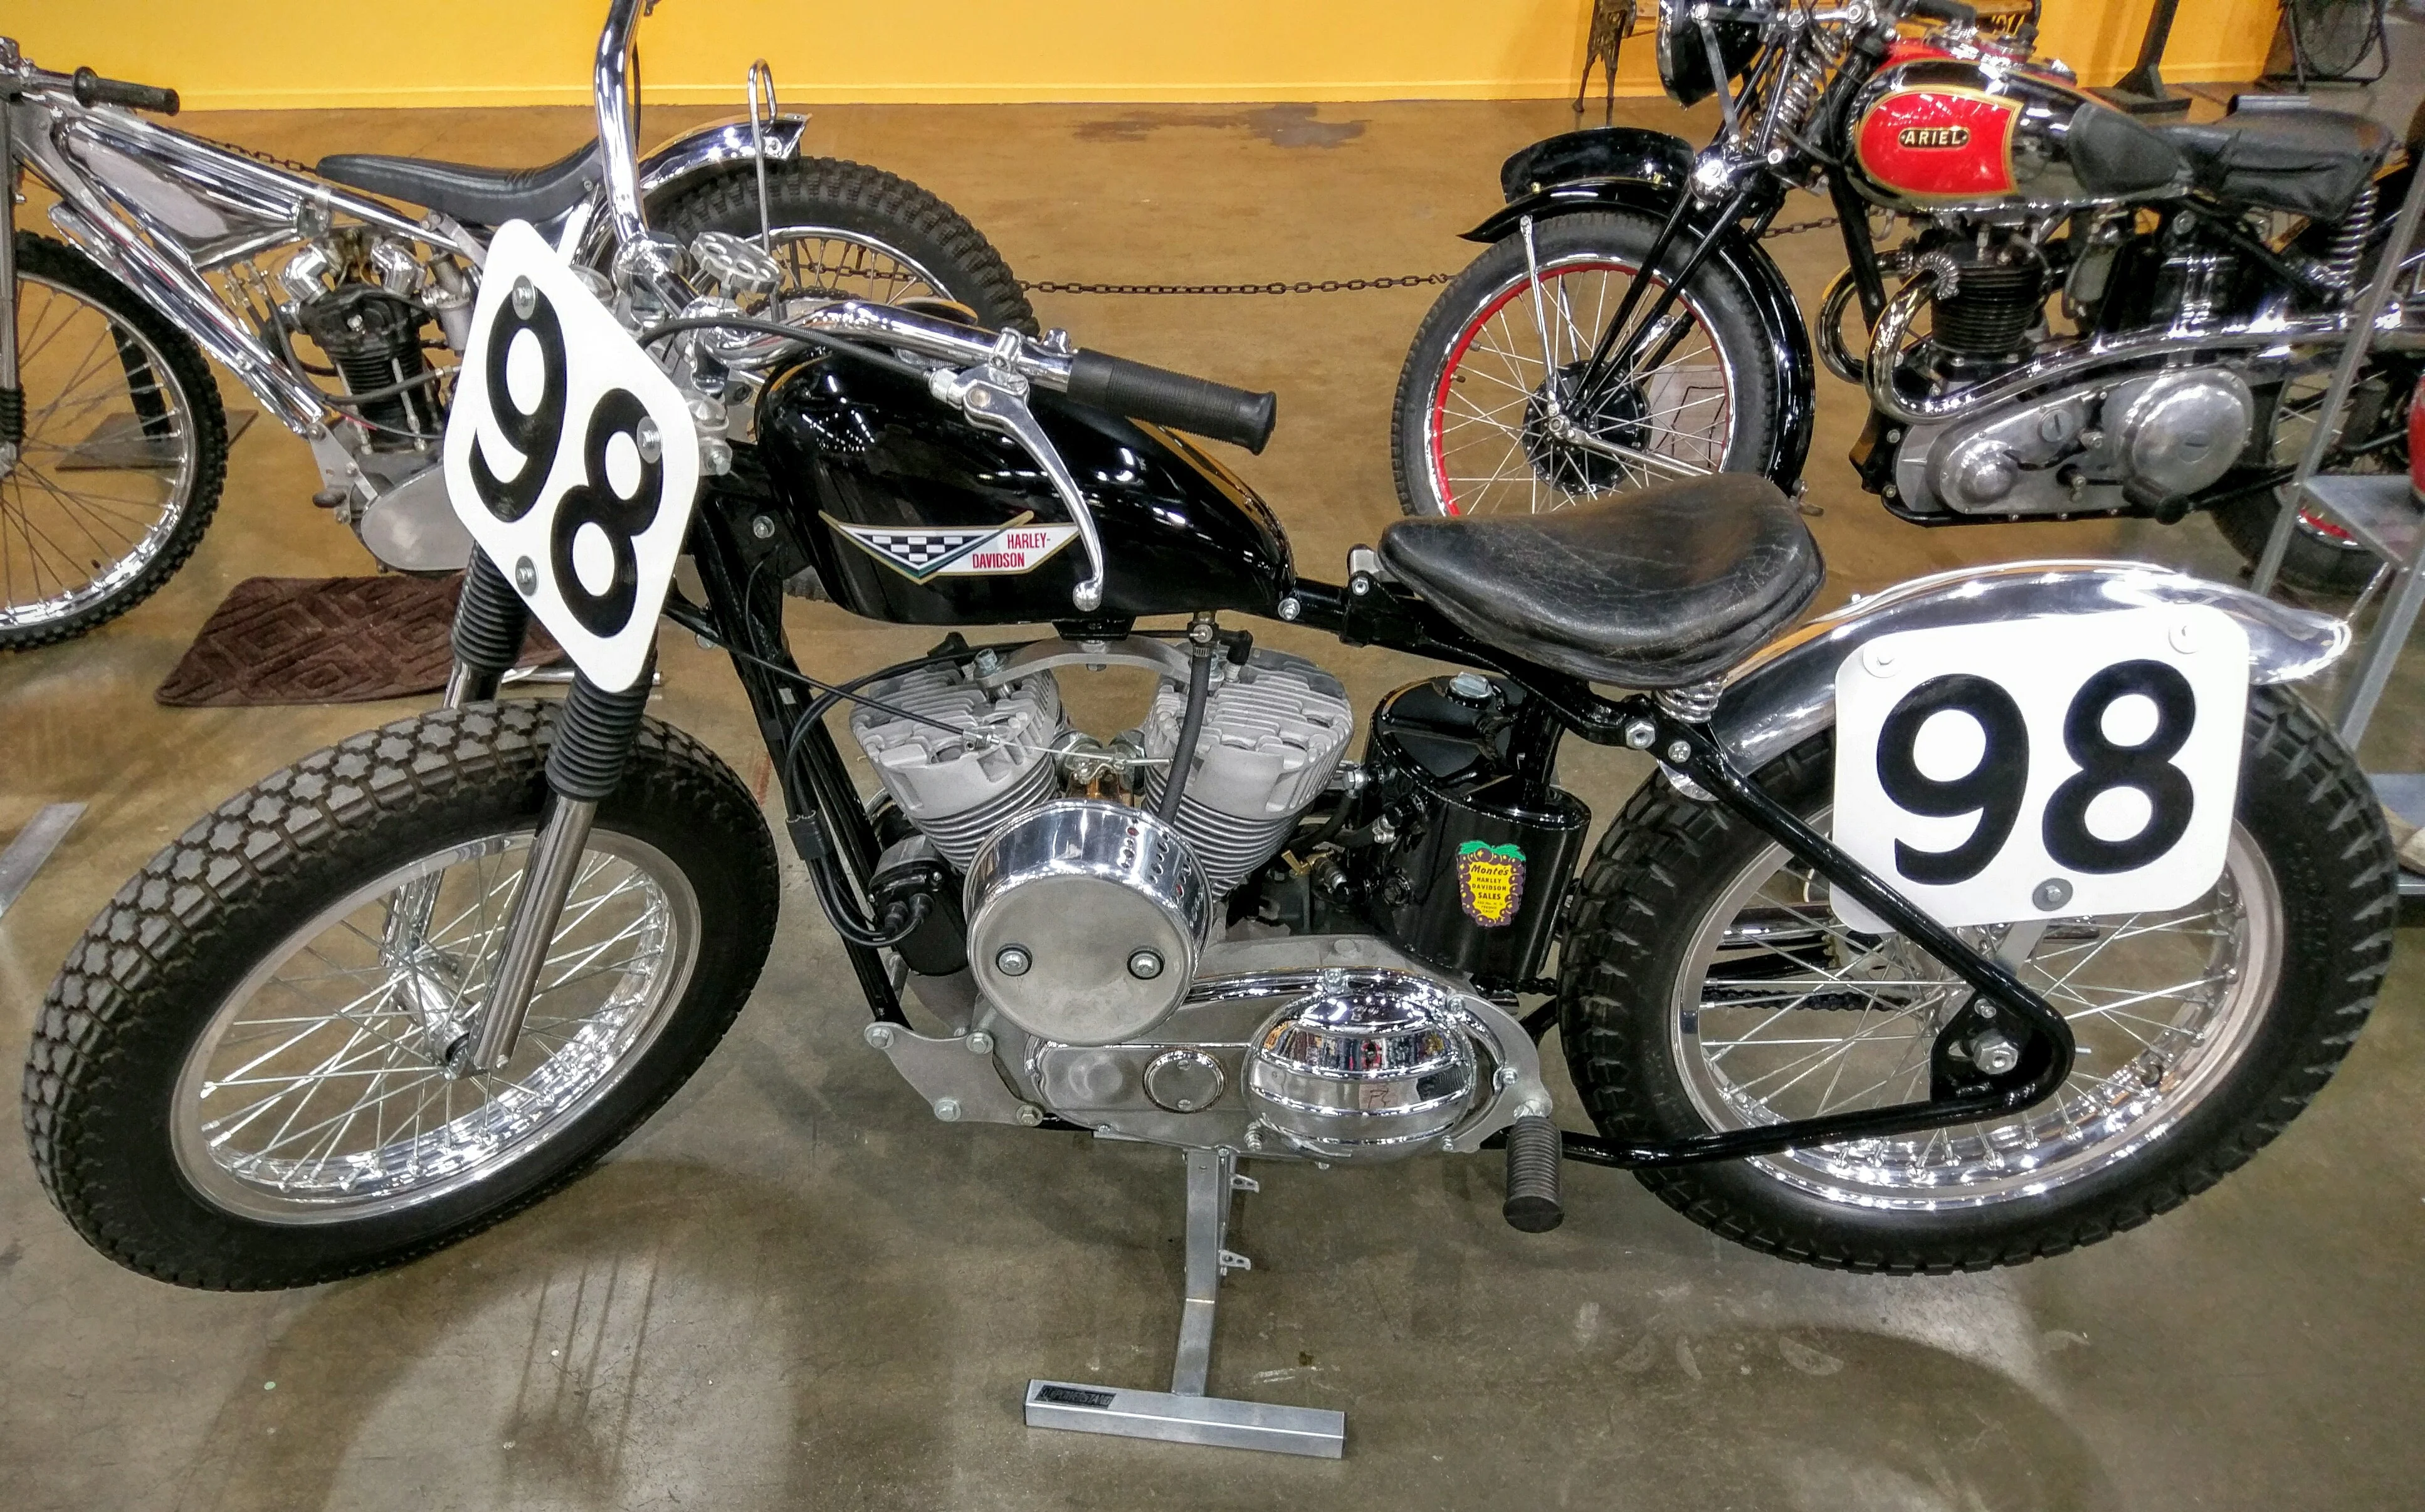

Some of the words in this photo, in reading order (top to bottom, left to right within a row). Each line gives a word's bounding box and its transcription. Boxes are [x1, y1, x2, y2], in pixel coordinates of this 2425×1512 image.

[1904, 130, 1960, 145] ARIEL
[468, 285, 665, 638] 98
[1007, 533, 1051, 549] HARLEY-
[972, 552, 1025, 569] DAVIDSON
[1876, 659, 2196, 885] 98
[1471, 865, 1509, 876] Monte's
